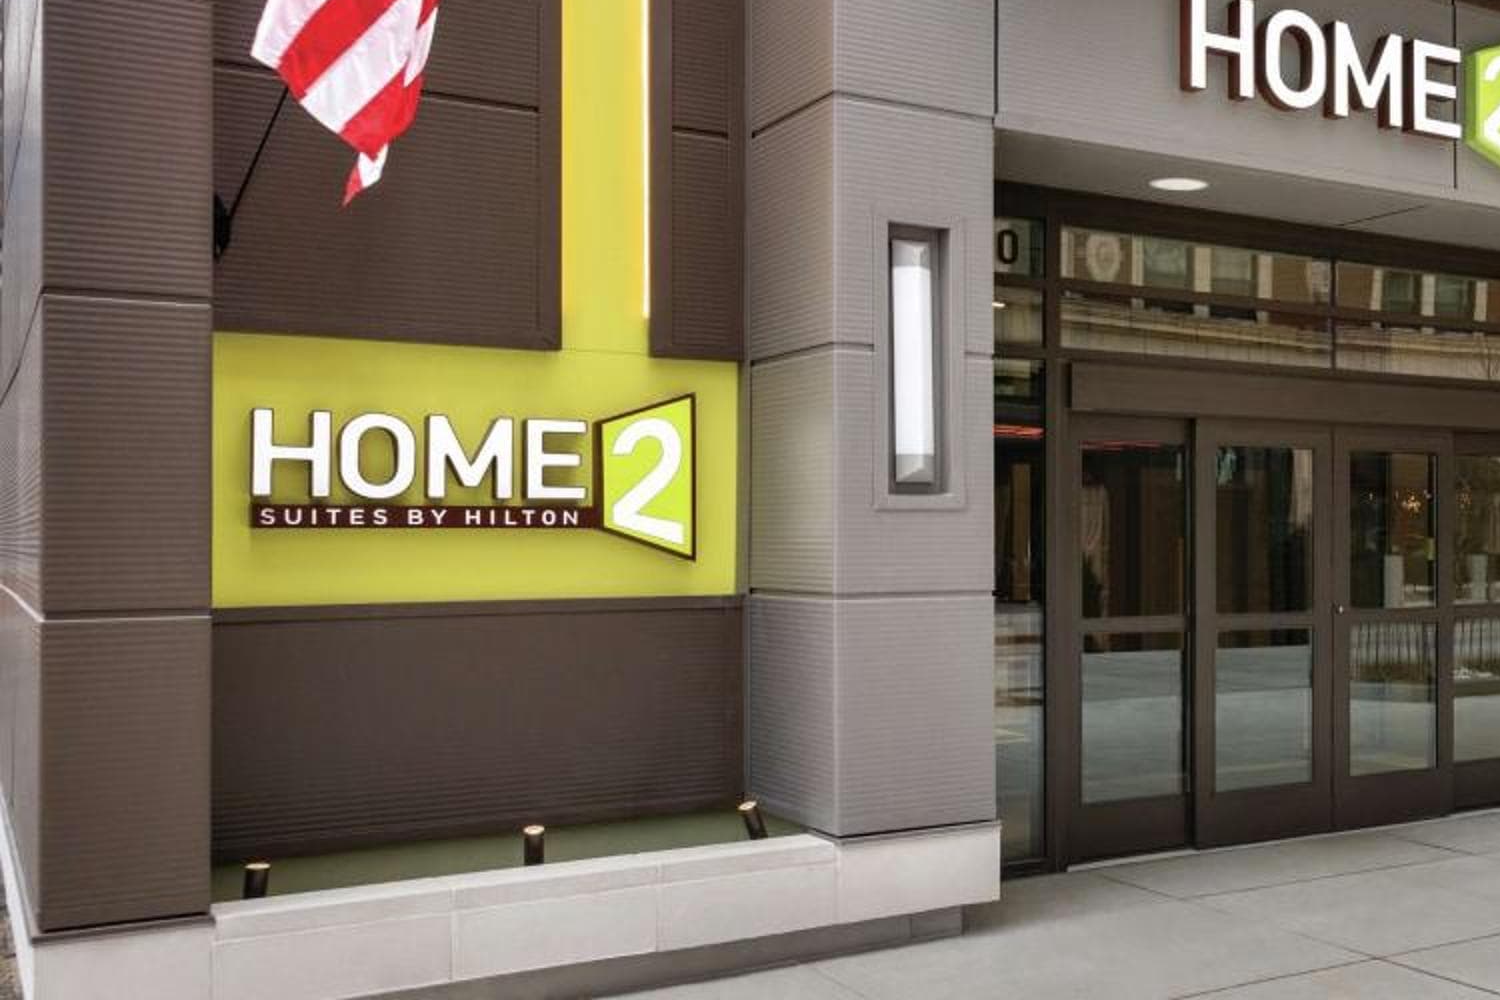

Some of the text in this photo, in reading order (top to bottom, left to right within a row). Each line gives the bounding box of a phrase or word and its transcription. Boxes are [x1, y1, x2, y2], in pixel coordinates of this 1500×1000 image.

[250, 407, 588, 500] HOME
[259, 507, 580, 526] SUITES BY HILTON
